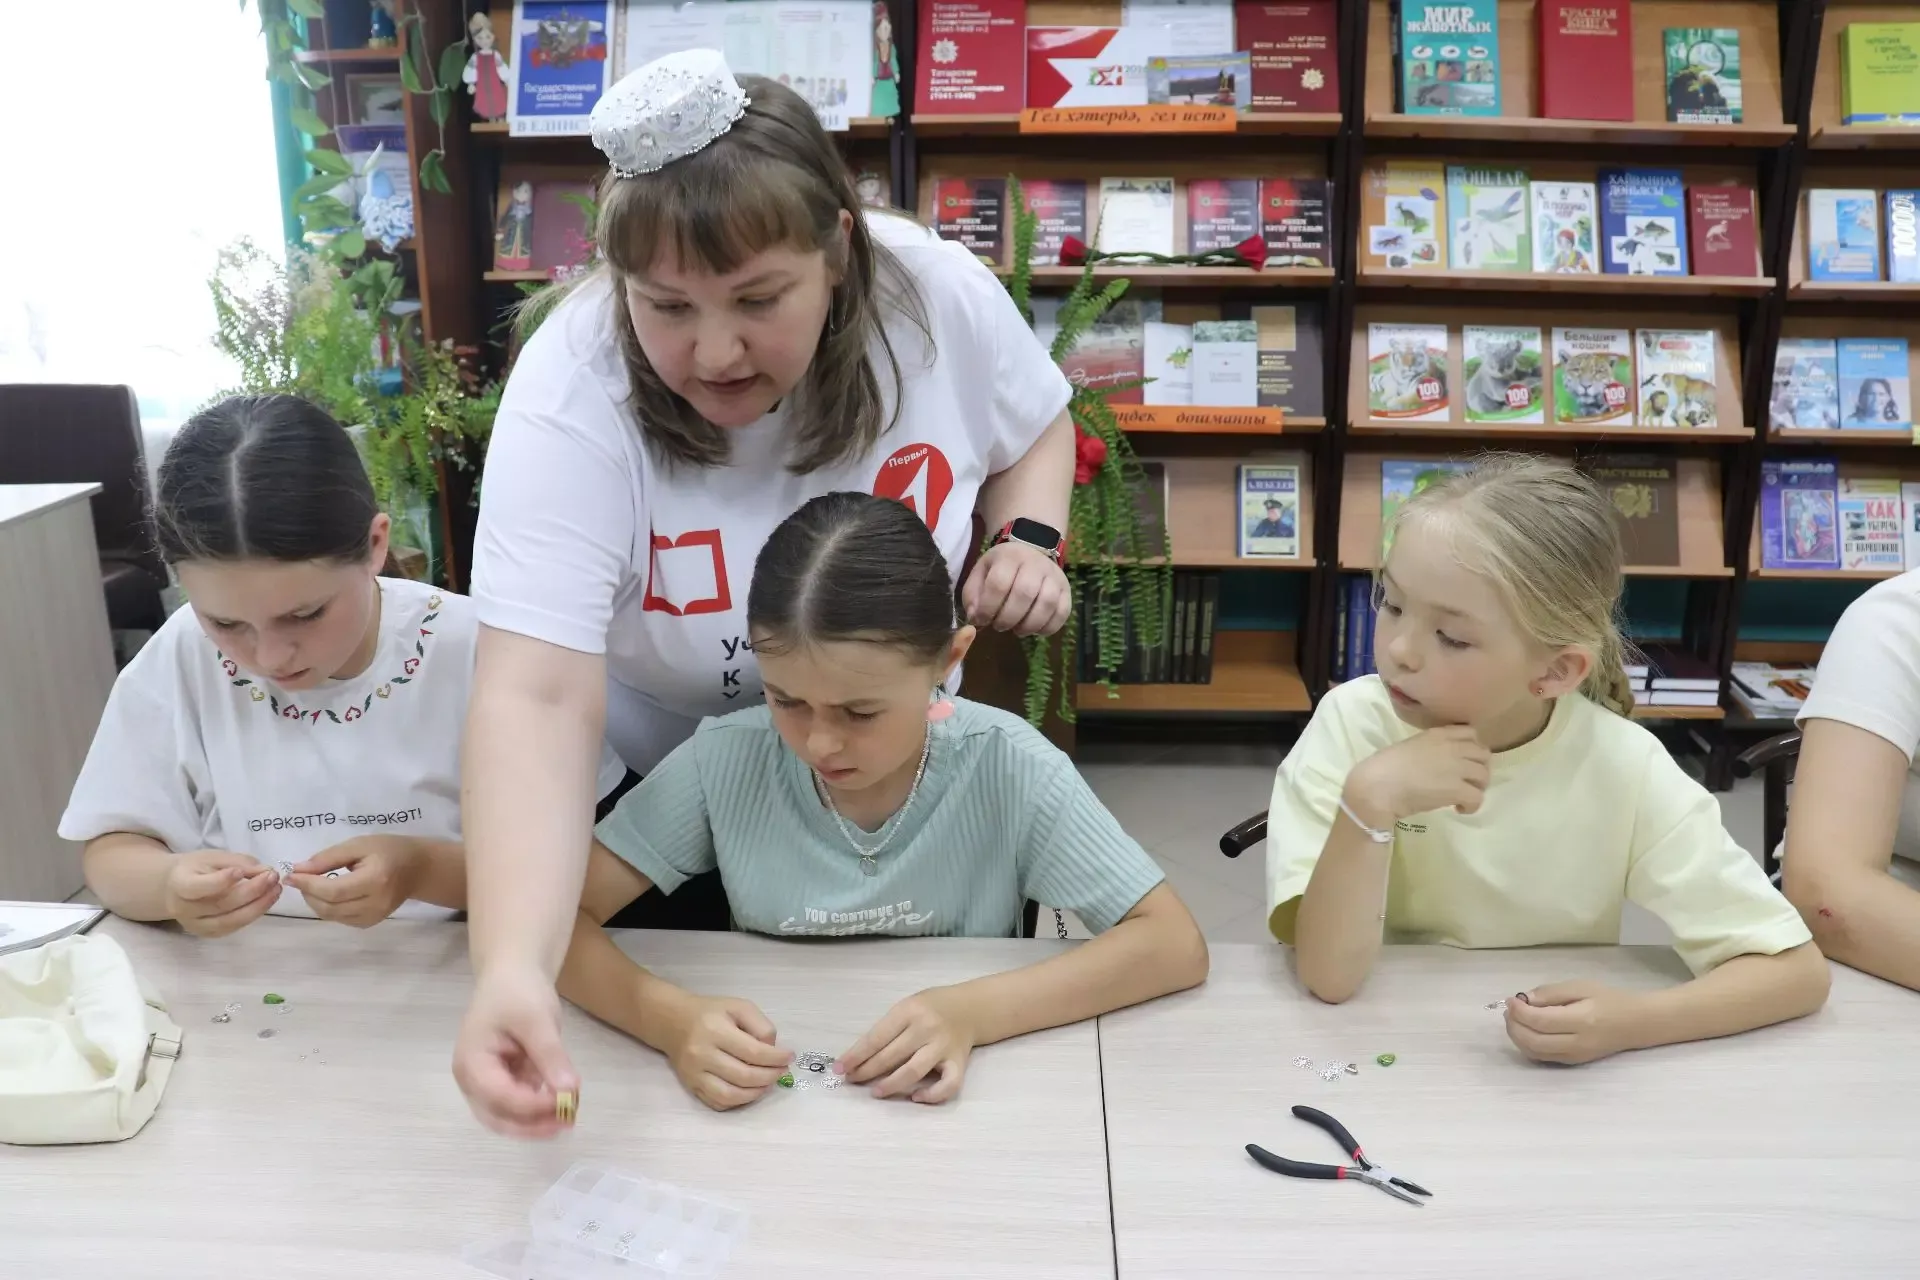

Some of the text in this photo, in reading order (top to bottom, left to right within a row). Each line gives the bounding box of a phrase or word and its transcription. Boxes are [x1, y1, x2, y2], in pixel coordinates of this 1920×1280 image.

[1423, 6, 1475, 23] МИР
[1560, 7, 1617, 19] КРАСНАЯ
[1406, 21, 1492, 33] ЖИВОТНЫХ
[1031, 109, 1061, 123] Гел
[1150, 112, 1178, 123] гел
[1453, 169, 1525, 187] КОШЛАР
[1564, 330, 1618, 343] Большие
[1418, 382, 1440, 396] 100
[1604, 387, 1626, 400] 100
[1506, 391, 1528, 404] 100
[1176, 411, 1266, 425] дошманны
[888, 447, 928, 468] Первые
[1866, 499, 1896, 519] КАК
[804, 900, 913, 924] YOU CONTINUE TO
